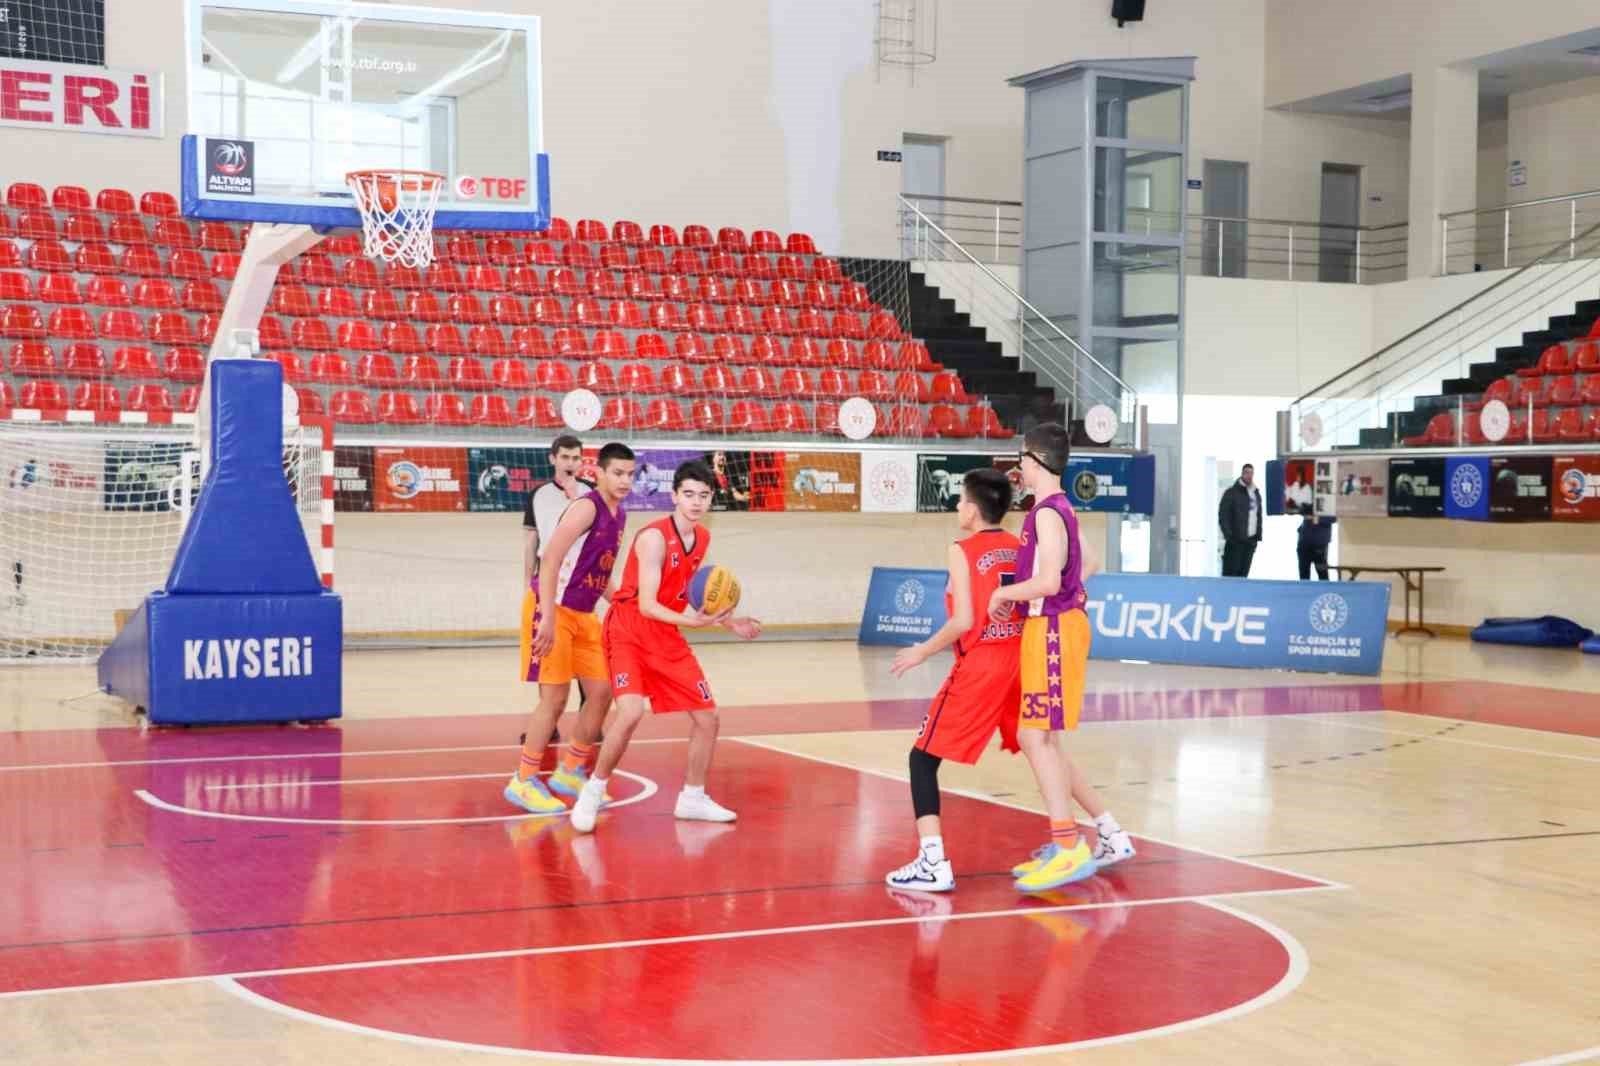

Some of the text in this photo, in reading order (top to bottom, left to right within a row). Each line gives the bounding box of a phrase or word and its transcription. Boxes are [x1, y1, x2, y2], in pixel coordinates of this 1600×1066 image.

[209, 175, 252, 186] ALTYAPI
[481, 176, 528, 199] TBF
[1288, 645, 1310, 656] SPOR
[1022, 692, 1049, 719] 35
